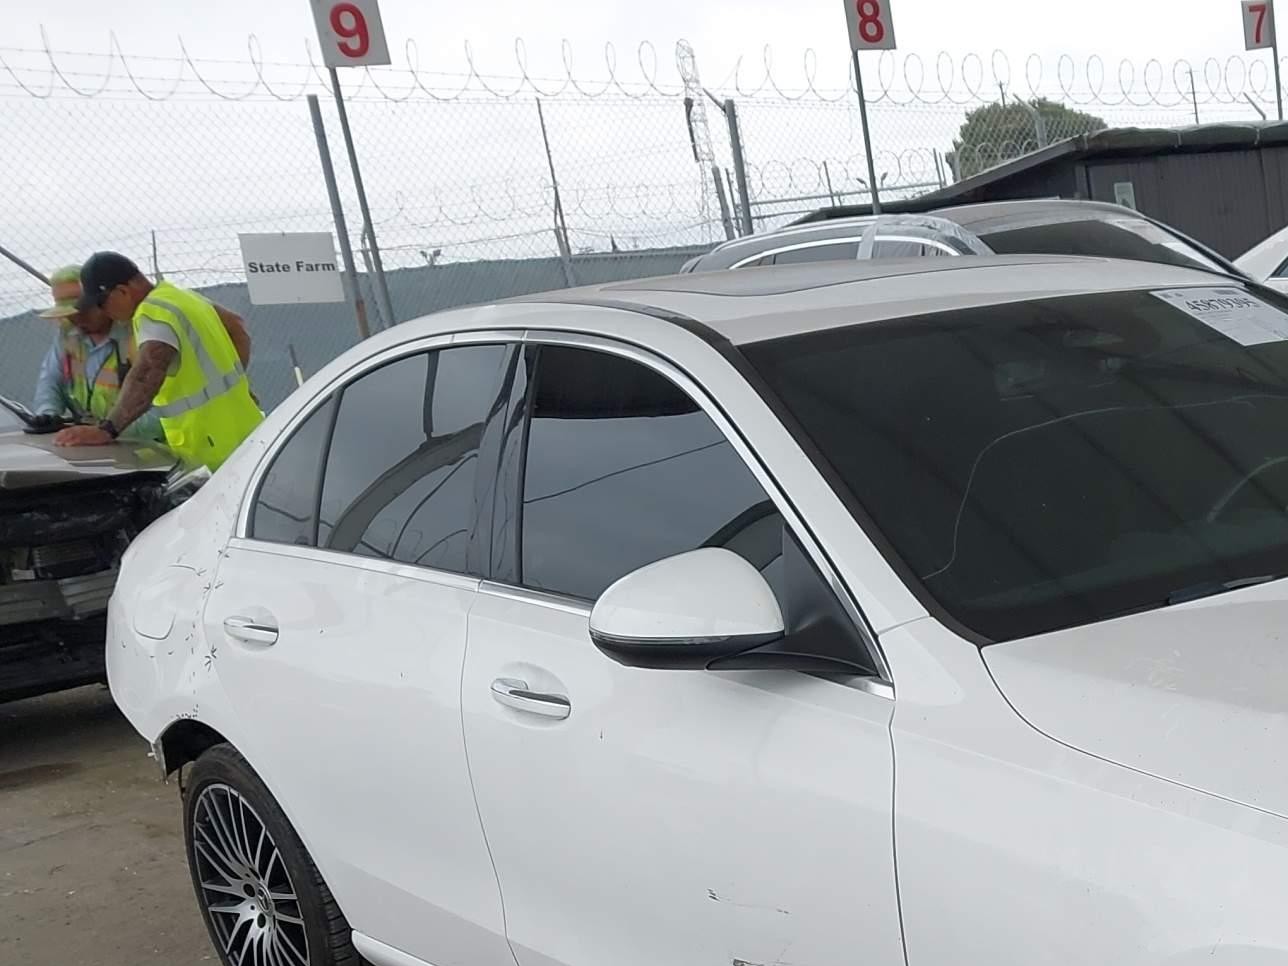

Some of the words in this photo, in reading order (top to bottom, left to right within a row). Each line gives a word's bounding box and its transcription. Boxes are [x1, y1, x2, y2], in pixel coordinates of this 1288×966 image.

[330, 3, 369, 58] 9
[857, 0, 884, 43] 8
[1248, 4, 1266, 44] 7
[248, 261, 291, 273] State
[295, 261, 336, 272] Farm
